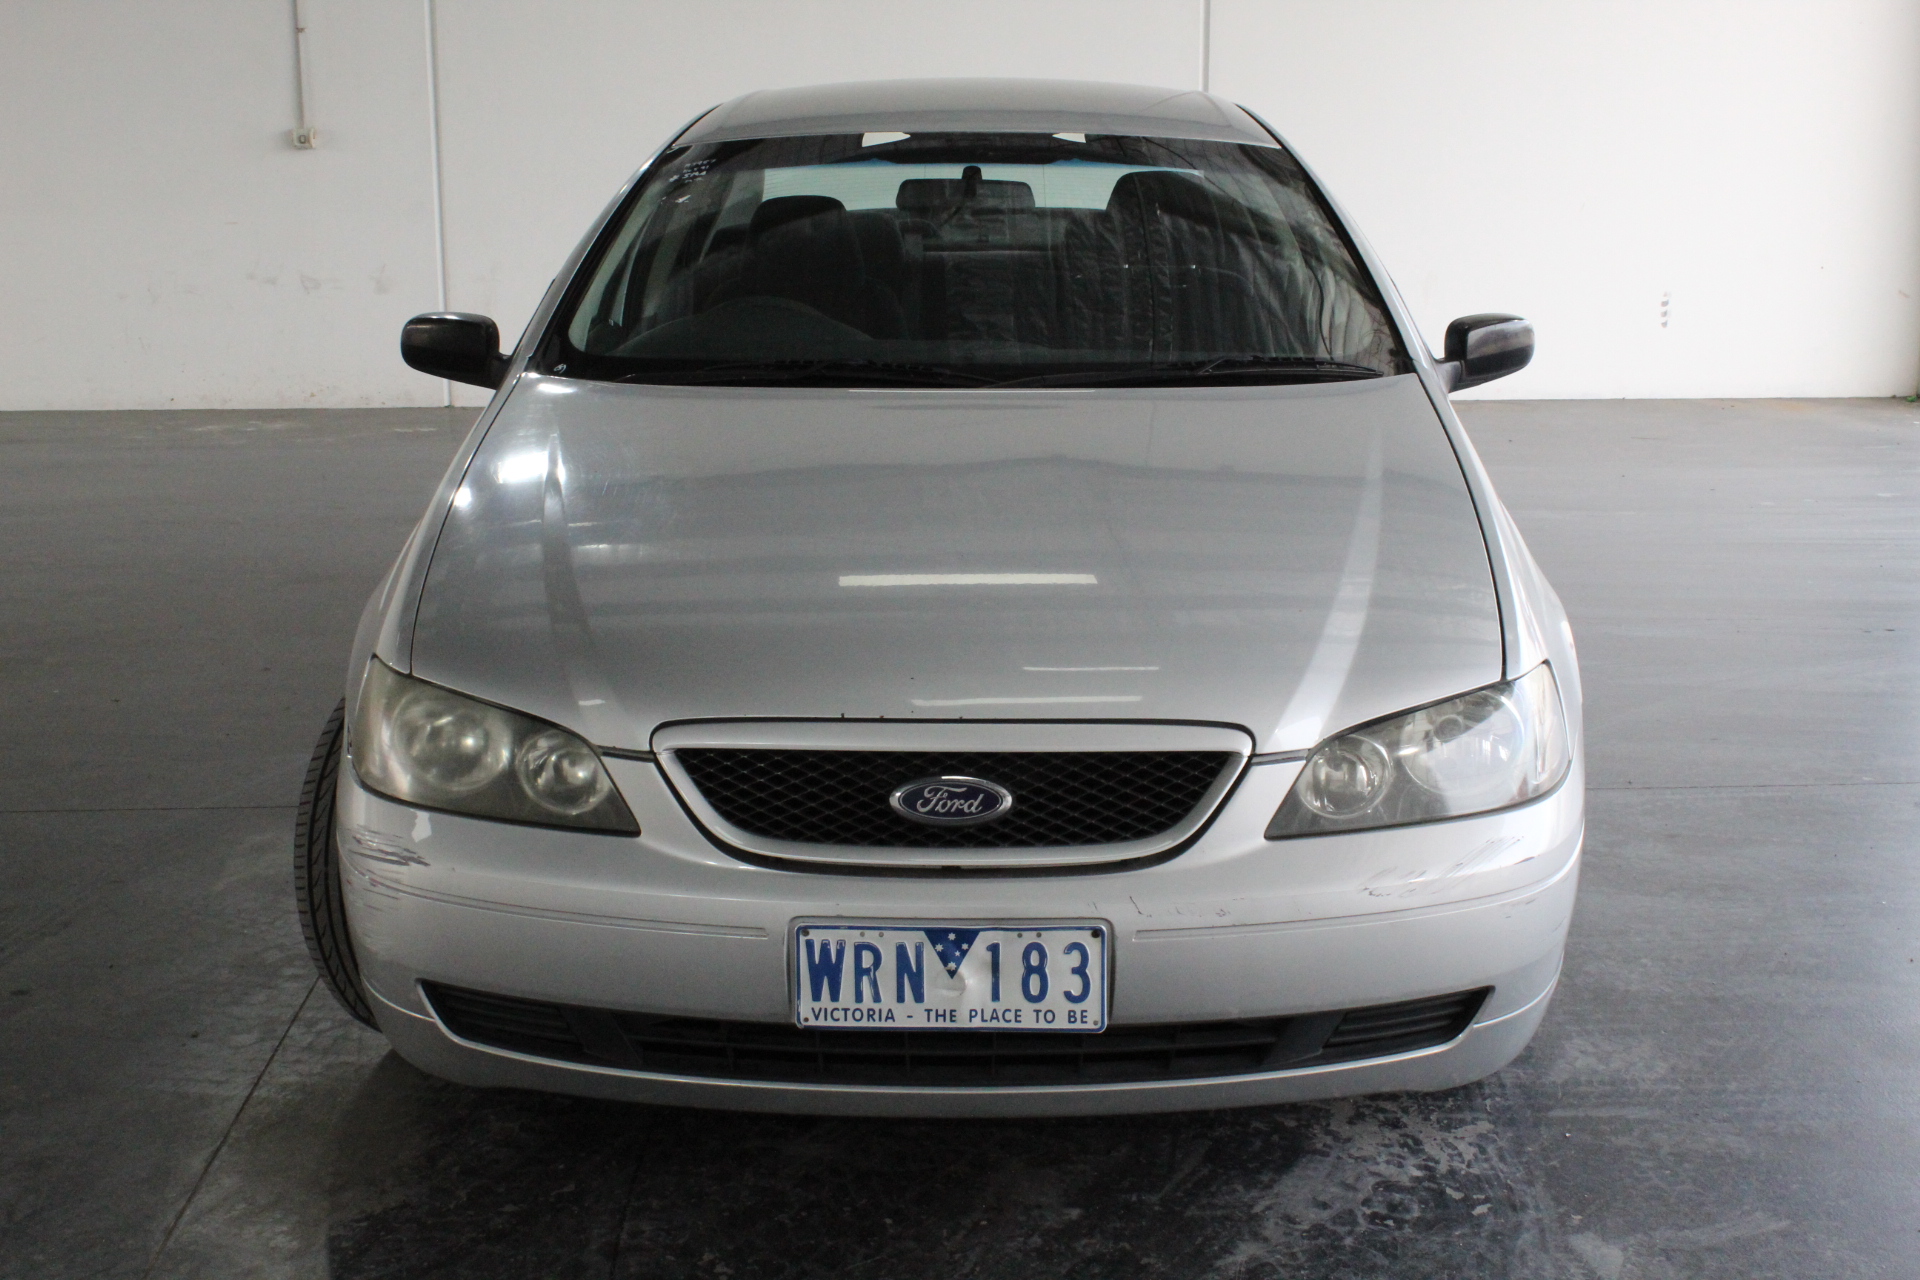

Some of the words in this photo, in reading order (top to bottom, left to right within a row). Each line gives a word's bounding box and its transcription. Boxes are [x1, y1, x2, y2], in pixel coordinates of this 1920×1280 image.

[916, 785, 985, 813] Ford
[804, 939, 925, 1004] WRN
[985, 941, 1092, 1004] 183
[811, 1007, 896, 1023] VICTORIA
[924, 1008, 957, 1023] THE
[969, 1009, 1022, 1023] PLACE
[1033, 1009, 1056, 1024] TO
[1067, 1009, 1089, 1024] BE
